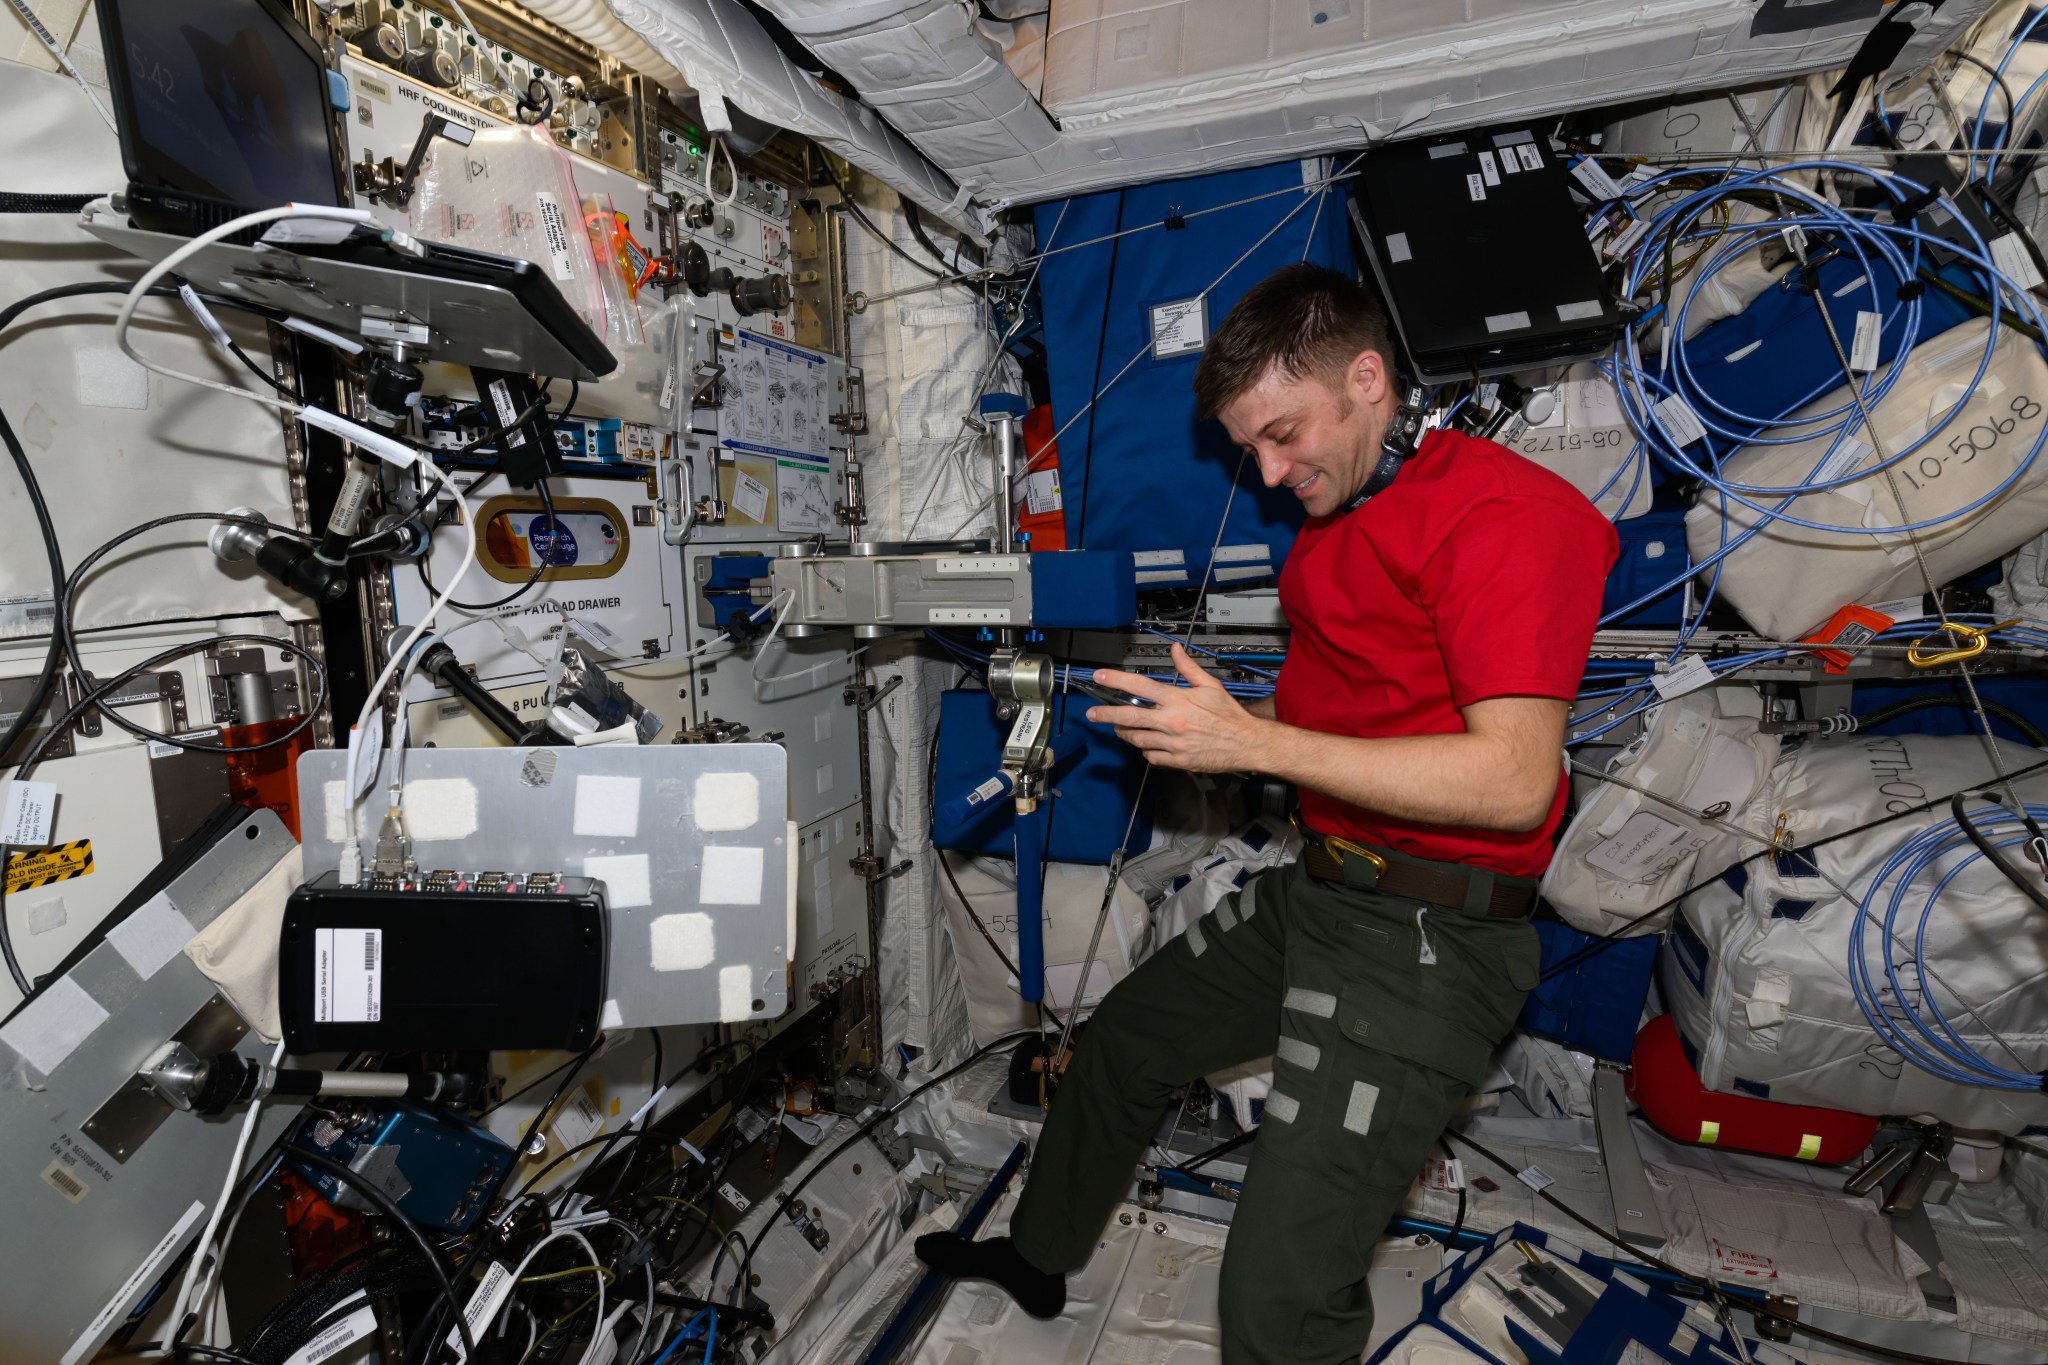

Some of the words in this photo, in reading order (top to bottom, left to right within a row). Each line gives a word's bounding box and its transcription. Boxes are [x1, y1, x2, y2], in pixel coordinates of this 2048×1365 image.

[398, 85, 420, 101] HRF
[422, 96, 468, 122] COOLING
[546, 202, 554, 222] Serial
[550, 223, 562, 252] Adapter
[552, 203, 564, 236] Multiport
[1409, 387, 1422, 406] ETZL
[524, 600, 576, 615] PAYLOAD
[578, 597, 620, 610] DRAWER
[513, 700, 519, 712] 8
[523, 698, 538, 710] PU
[1016, 710, 1032, 742] RESTRAINT
[1025, 722, 1033, 734] LEG
[25, 816, 31, 824] DC
[34, 803, 42, 824] OUTPUT
[5, 835, 12, 844] P2
[31, 824, 40, 840] Supply
[8, 856, 46, 870] ARNING
[6, 870, 26, 880] OLD
[28, 862, 57, 876] INSIDE
[29, 872, 46, 883] MUST
[57, 865, 77, 875] WORN
[60, 1134, 72, 1146] P/N
[50, 1142, 62, 1155] S/N
[734, 1191, 742, 1200] 4
[736, 1200, 746, 1210] D
[1730, 1250, 1758, 1260] FIRE
[1726, 1258, 1769, 1269] EXTINGUISHER
[308, 1338, 324, 1349] Cable
[324, 1324, 346, 1339] Assembly
